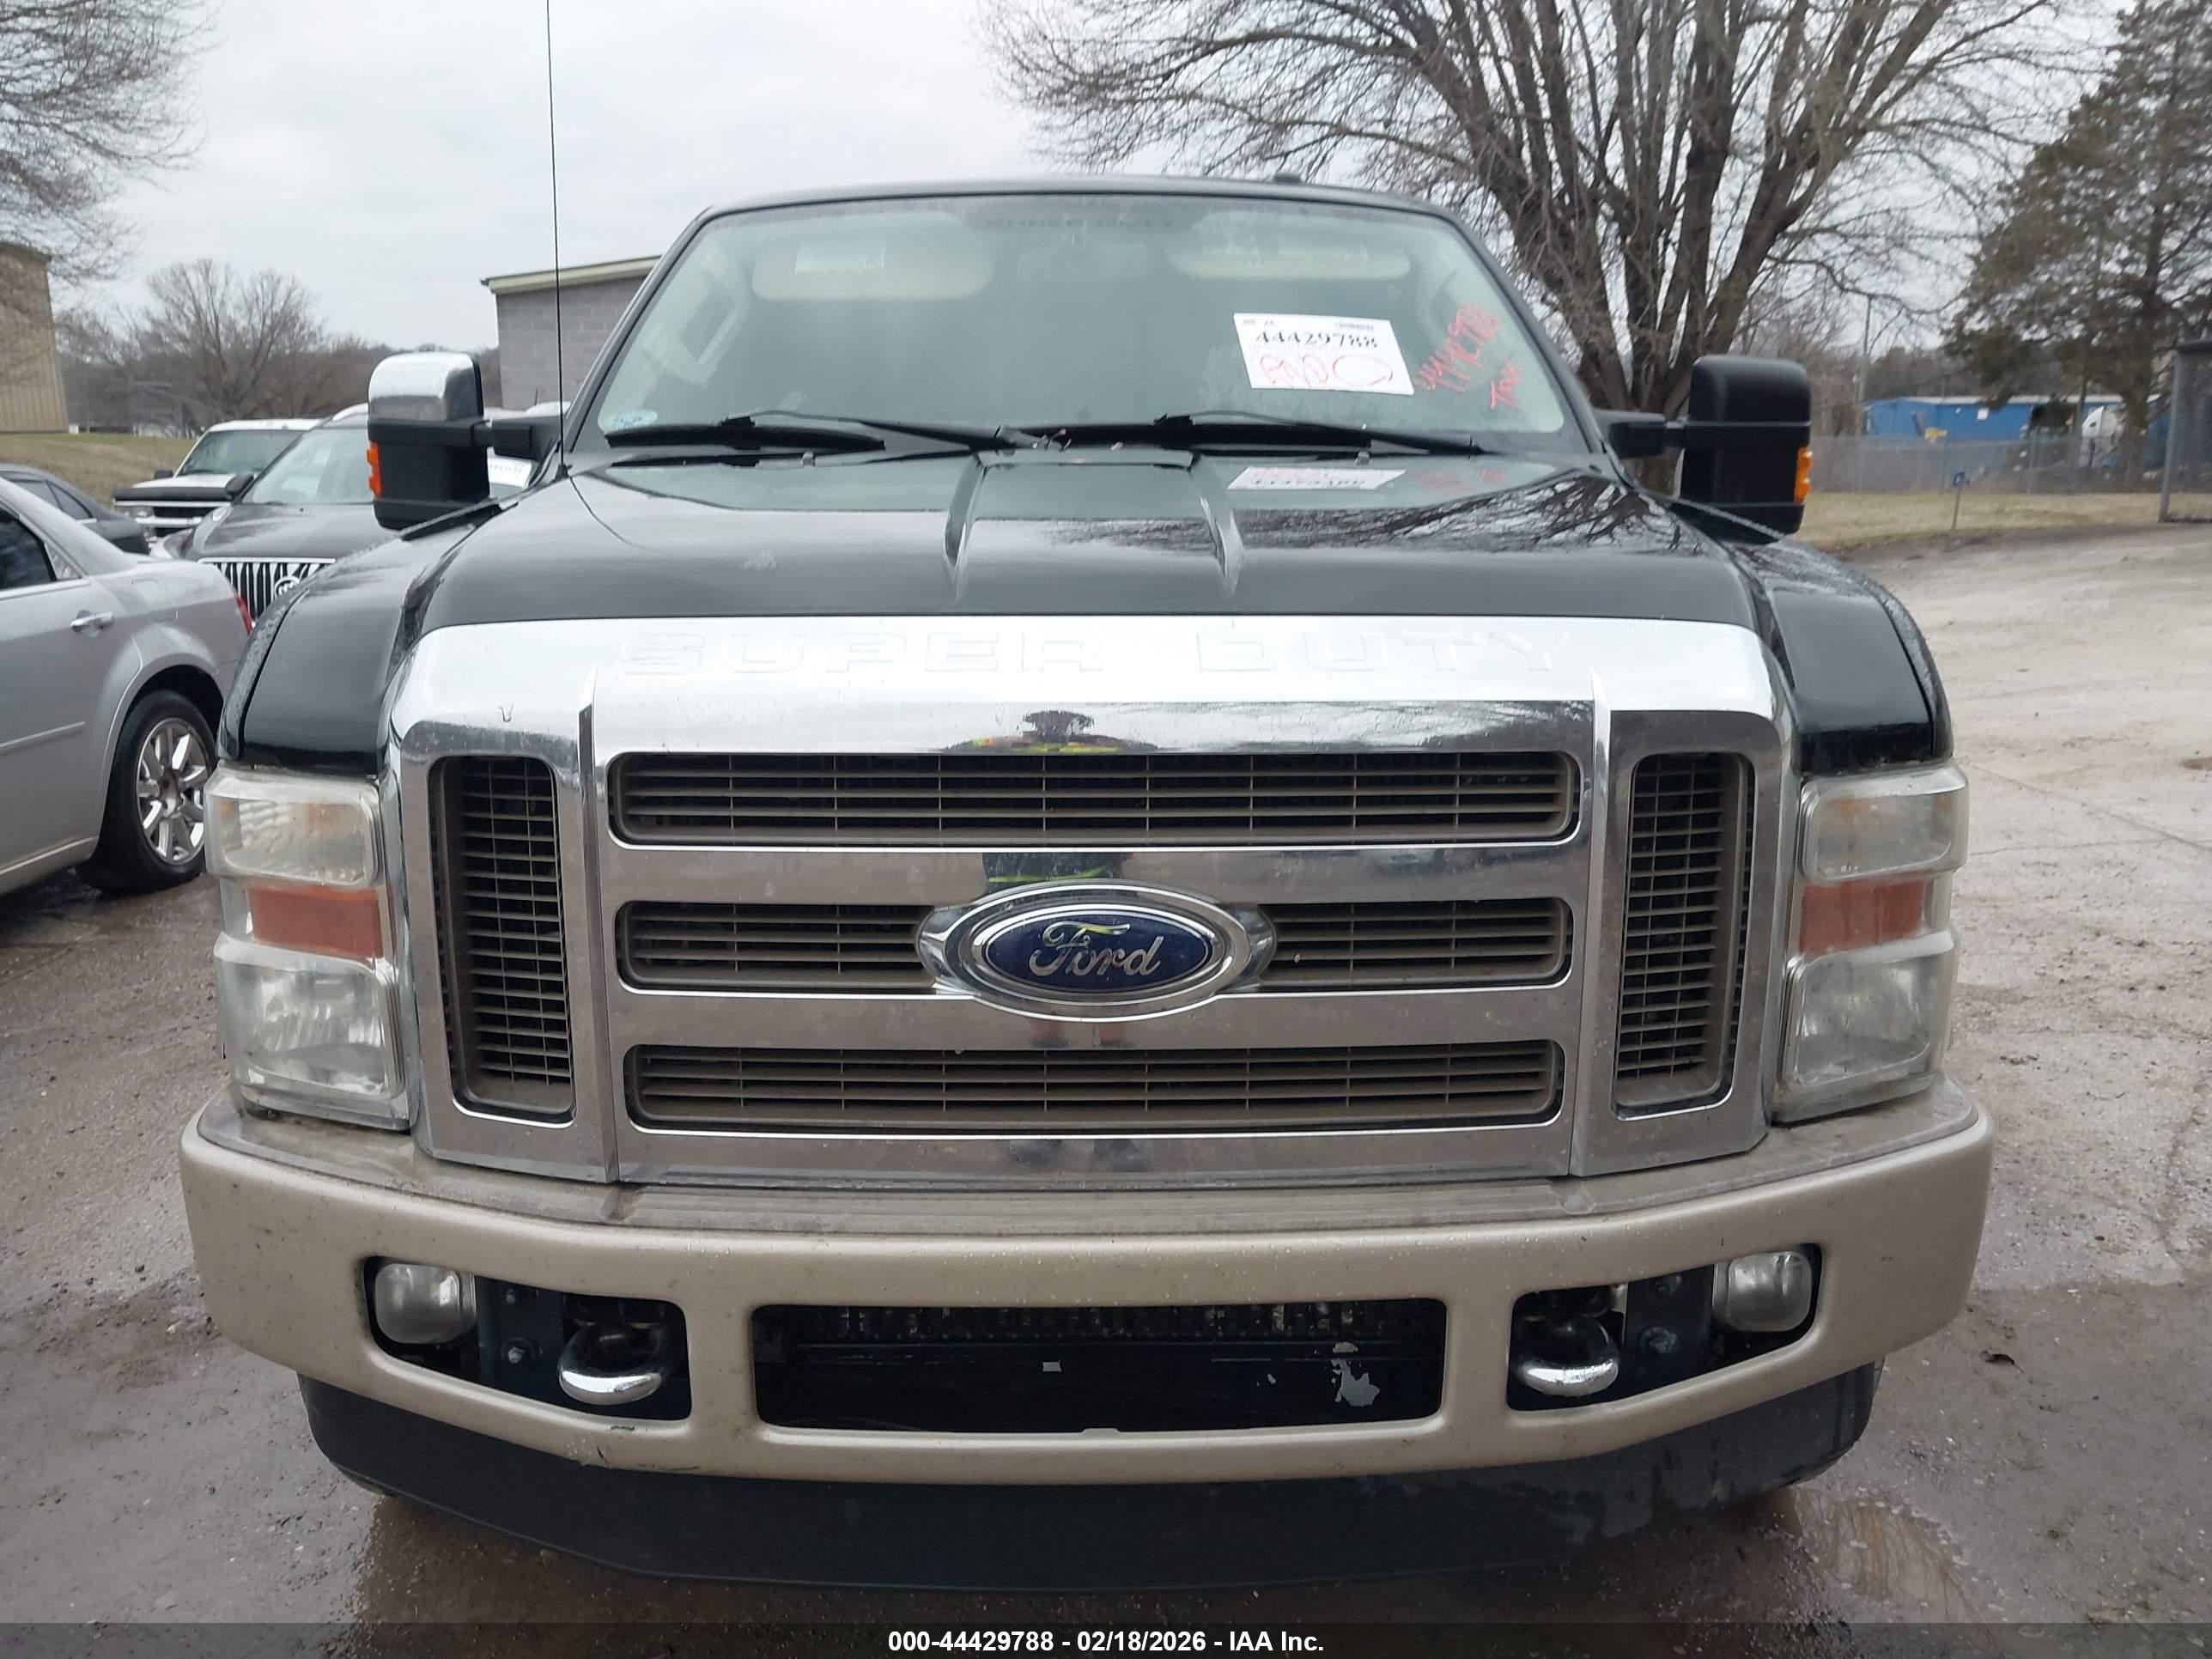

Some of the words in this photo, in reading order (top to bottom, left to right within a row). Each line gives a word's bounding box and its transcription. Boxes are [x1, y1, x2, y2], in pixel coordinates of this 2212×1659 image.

[1256, 330, 1378, 349] 44429788
[619, 631, 1104, 675] SUPER
[1196, 630, 1571, 672] DUTY
[1029, 921, 1164, 976] Ford
